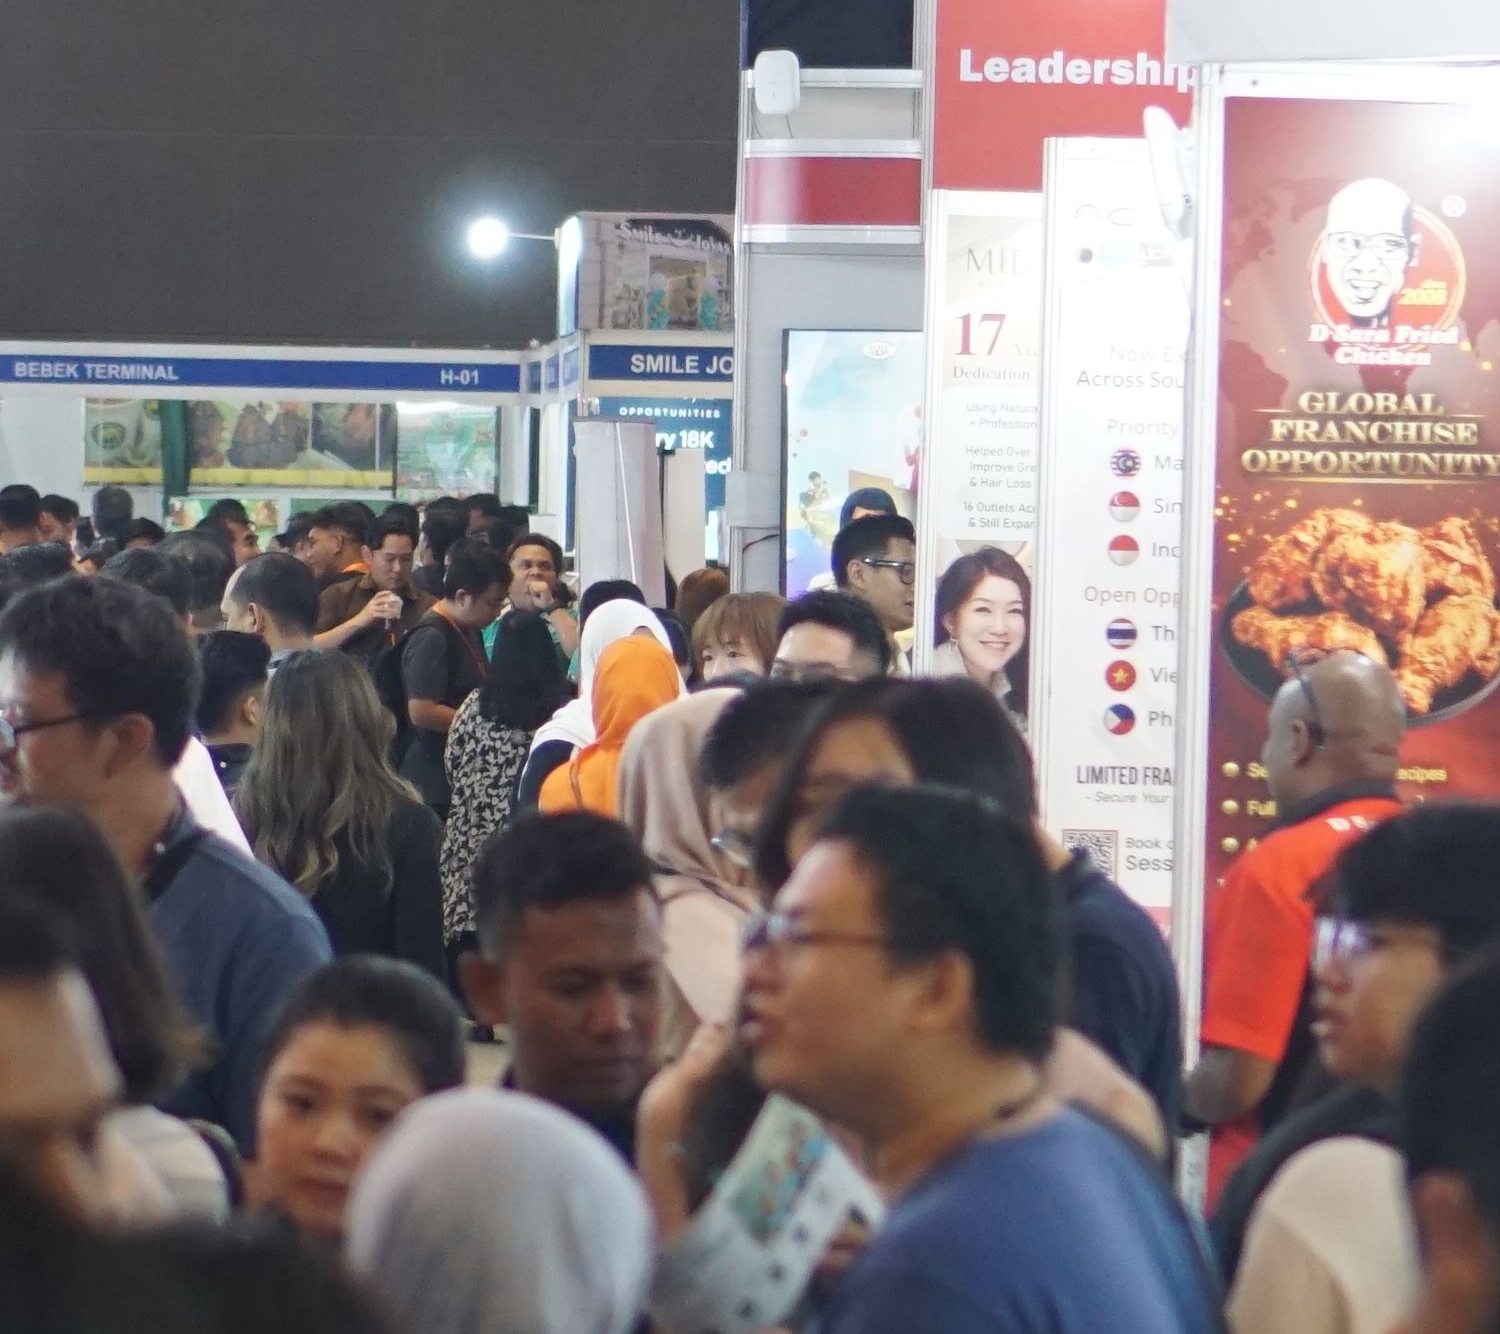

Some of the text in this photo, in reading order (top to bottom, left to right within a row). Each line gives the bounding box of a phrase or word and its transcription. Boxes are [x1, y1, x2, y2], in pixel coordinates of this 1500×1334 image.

[954, 312, 1007, 356] 17
[1393, 325, 1459, 344] Fried
[1110, 345, 1156, 362] Now
[1334, 347, 1432, 365] Chicken
[630, 354, 699, 374] SMILE
[953, 366, 1031, 380] Dedication
[13, 361, 480, 387] BEBEK TERMINAL H-01
[1076, 369, 1145, 387] Across
[619, 407, 721, 418] OPPORTUNITIES
[966, 403, 997, 414] Using
[1298, 391, 1444, 416] GLOBAL
[1107, 419, 1180, 440] Priority
[1269, 419, 1478, 445] FRANCHISE
[680, 430, 714, 448] 18K
[965, 447, 1031, 457] Helped Over
[970, 462, 1014, 473] Improve
[980, 478, 1003, 487] Hair
[1006, 479, 1032, 488] Loss
[963, 501, 1015, 513] 16 Outlets
[979, 517, 1000, 528] Still
[1084, 585, 1137, 606] Open
[1077, 765, 1138, 785] LIMITED
[1126, 837, 1162, 849] Book
